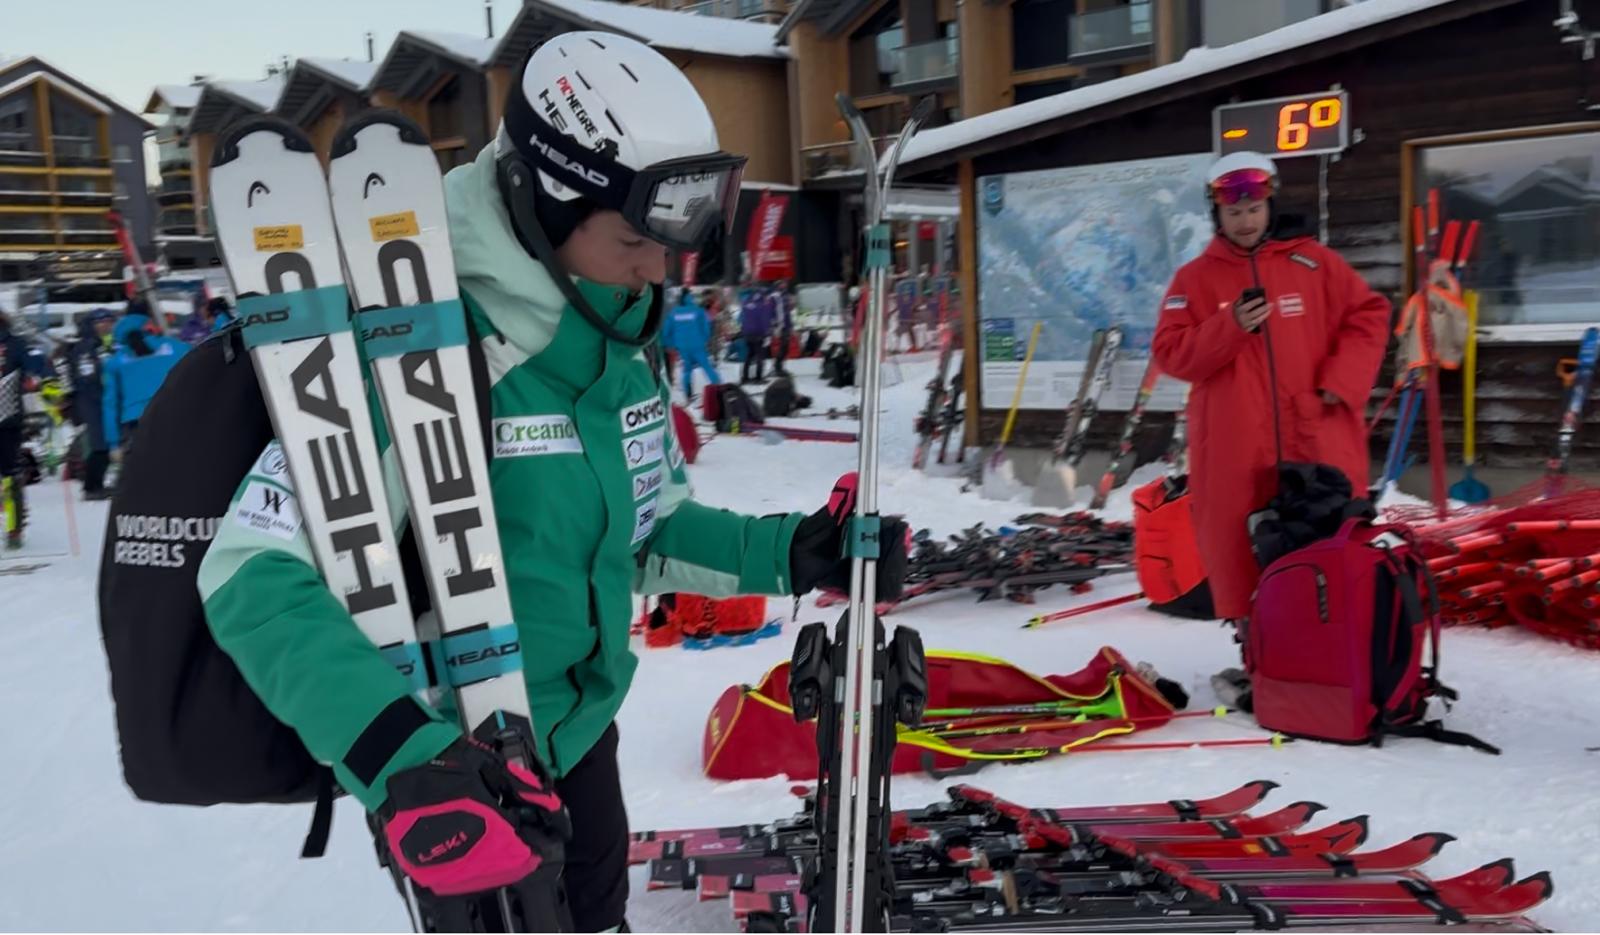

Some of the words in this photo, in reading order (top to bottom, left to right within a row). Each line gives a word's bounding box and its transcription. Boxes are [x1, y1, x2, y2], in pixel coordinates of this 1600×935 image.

[529, 134, 610, 188] HEAD
[114, 540, 186, 568] REBELS
[417, 831, 467, 863] LEKI
